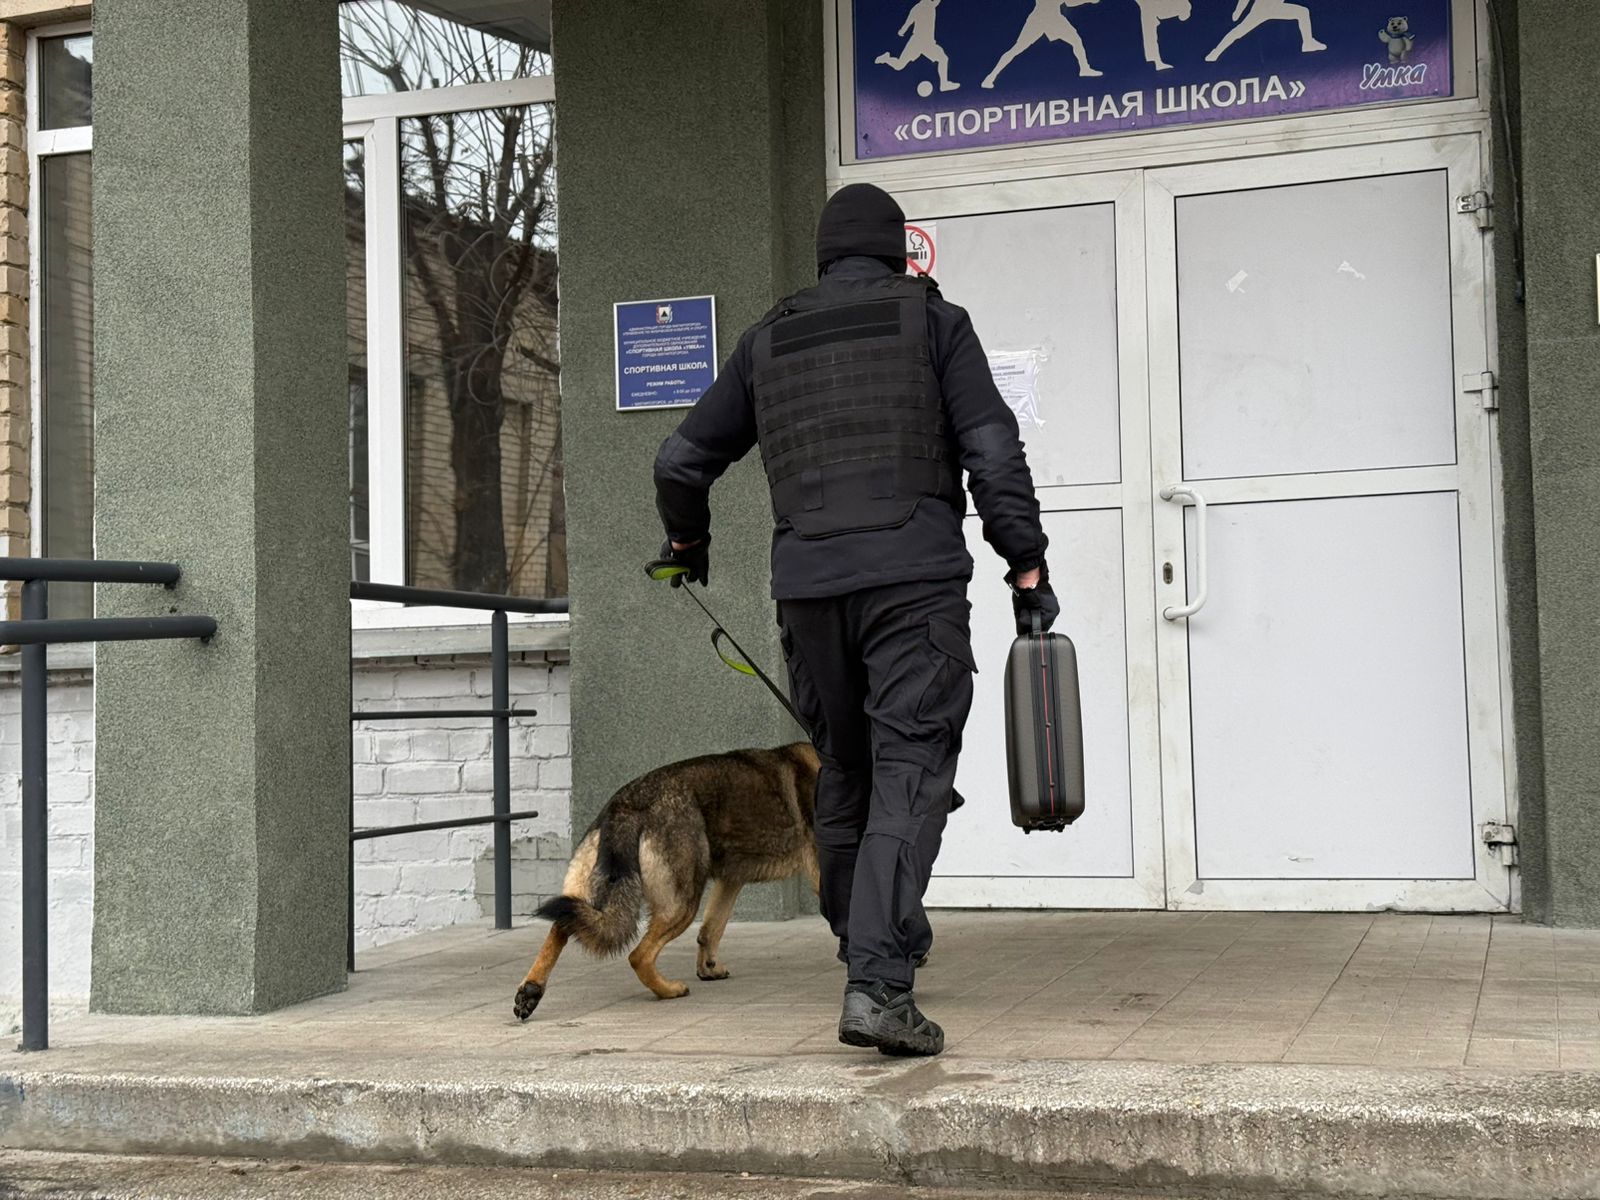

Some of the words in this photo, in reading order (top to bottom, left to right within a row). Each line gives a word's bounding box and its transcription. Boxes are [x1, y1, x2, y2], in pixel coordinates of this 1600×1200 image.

[1360, 63, 1427, 89] Умка
[894, 91, 1144, 142] «СПОРТИВНАЯ
[1156, 75, 1306, 111] ШКОЛА»
[624, 363, 677, 375] СПОРТИВНАЯ
[679, 361, 708, 370] ШКОЛА
